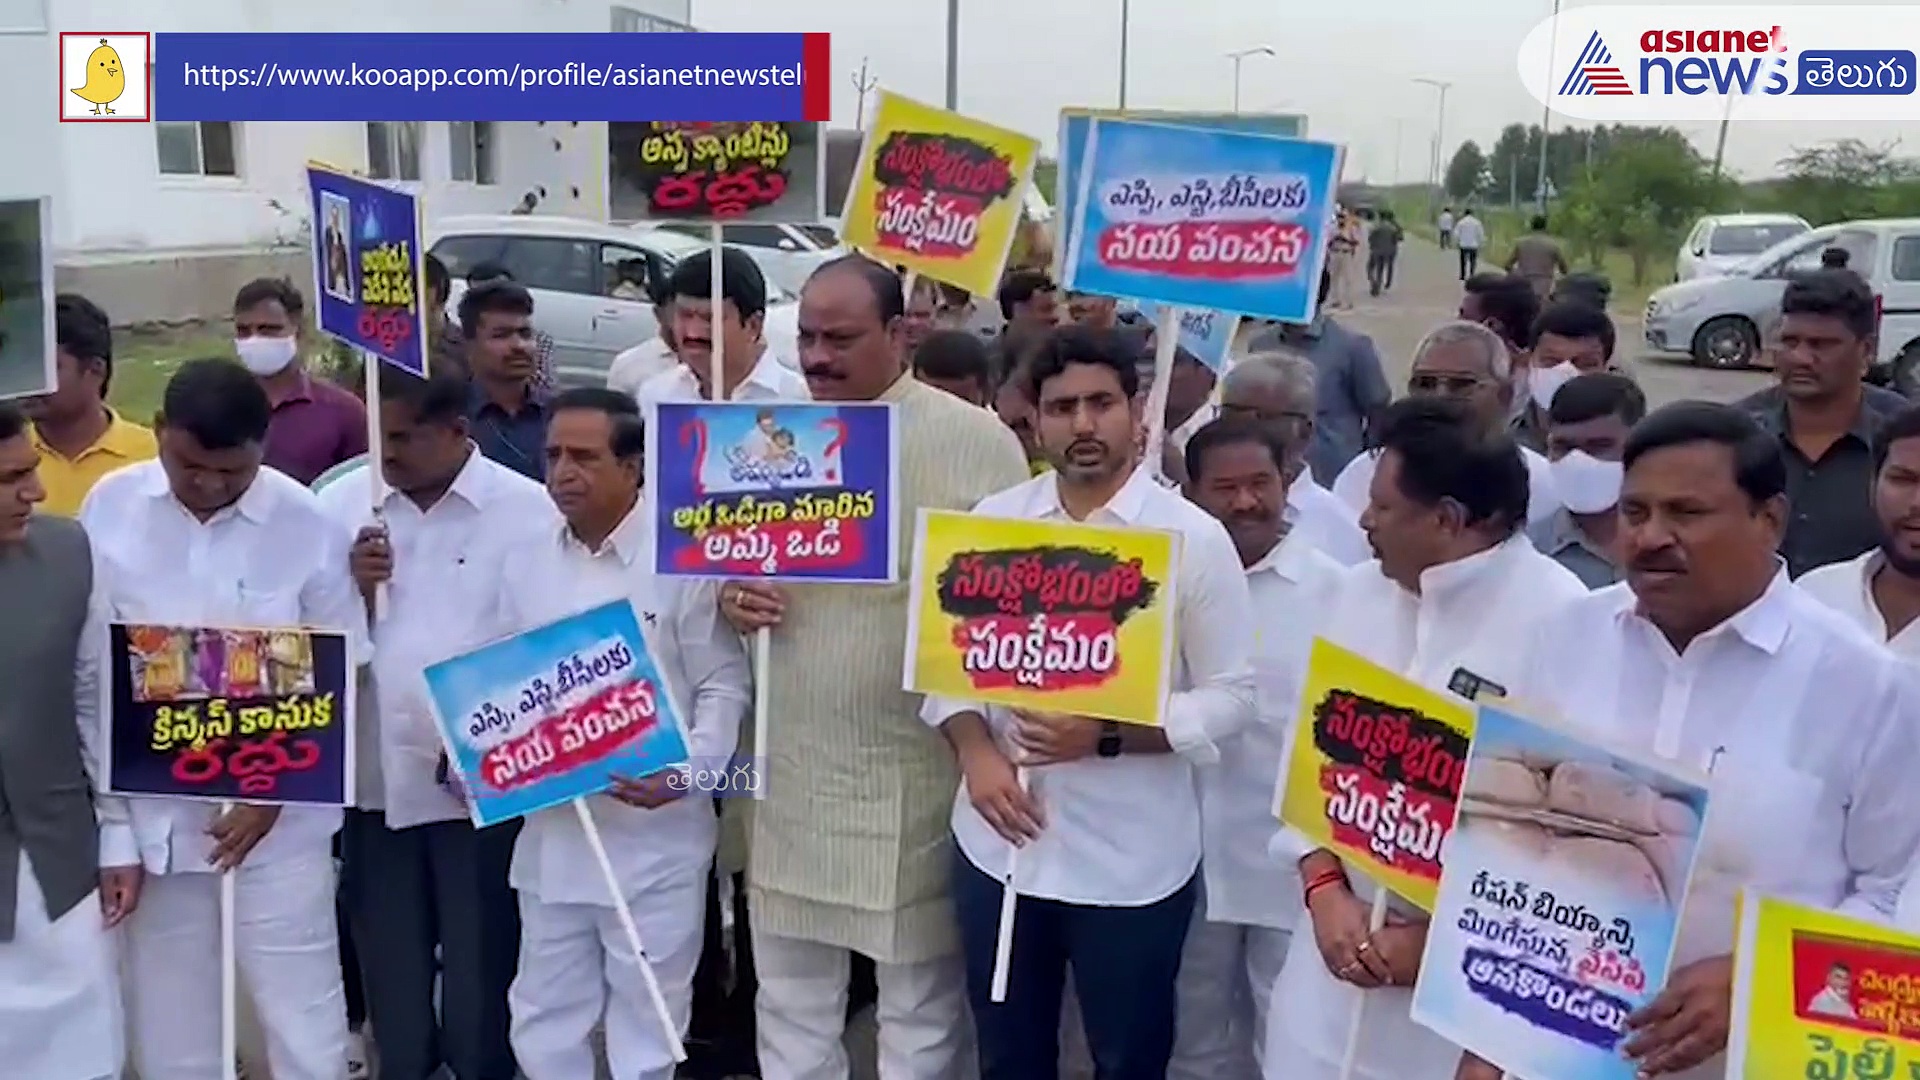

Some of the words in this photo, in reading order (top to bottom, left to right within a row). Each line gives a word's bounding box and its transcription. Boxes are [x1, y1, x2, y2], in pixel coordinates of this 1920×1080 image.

[641, 129, 688, 172] అన్న
[885, 133, 1014, 191] సంక్షోభంలో
[653, 166, 787, 219] రద్దు
[877, 189, 979, 251] సంక్షేమం
[1106, 223, 1180, 262] నయ
[1187, 223, 1303, 265] వంచన
[791, 489, 876, 522] మారిన
[704, 525, 778, 575] అమ్మ
[786, 517, 841, 558] ఒడి
[952, 553, 1144, 615] సంక్షోభంలో
[964, 612, 1119, 687] సంక్షేమం
[239, 690, 335, 736] కానుక
[489, 730, 556, 785] నయ
[557, 679, 656, 754] వంచన
[171, 731, 321, 792] రద్దు
[1471, 869, 1530, 911] రేషన్
[1532, 891, 1635, 958] బియ్యాన్ని
